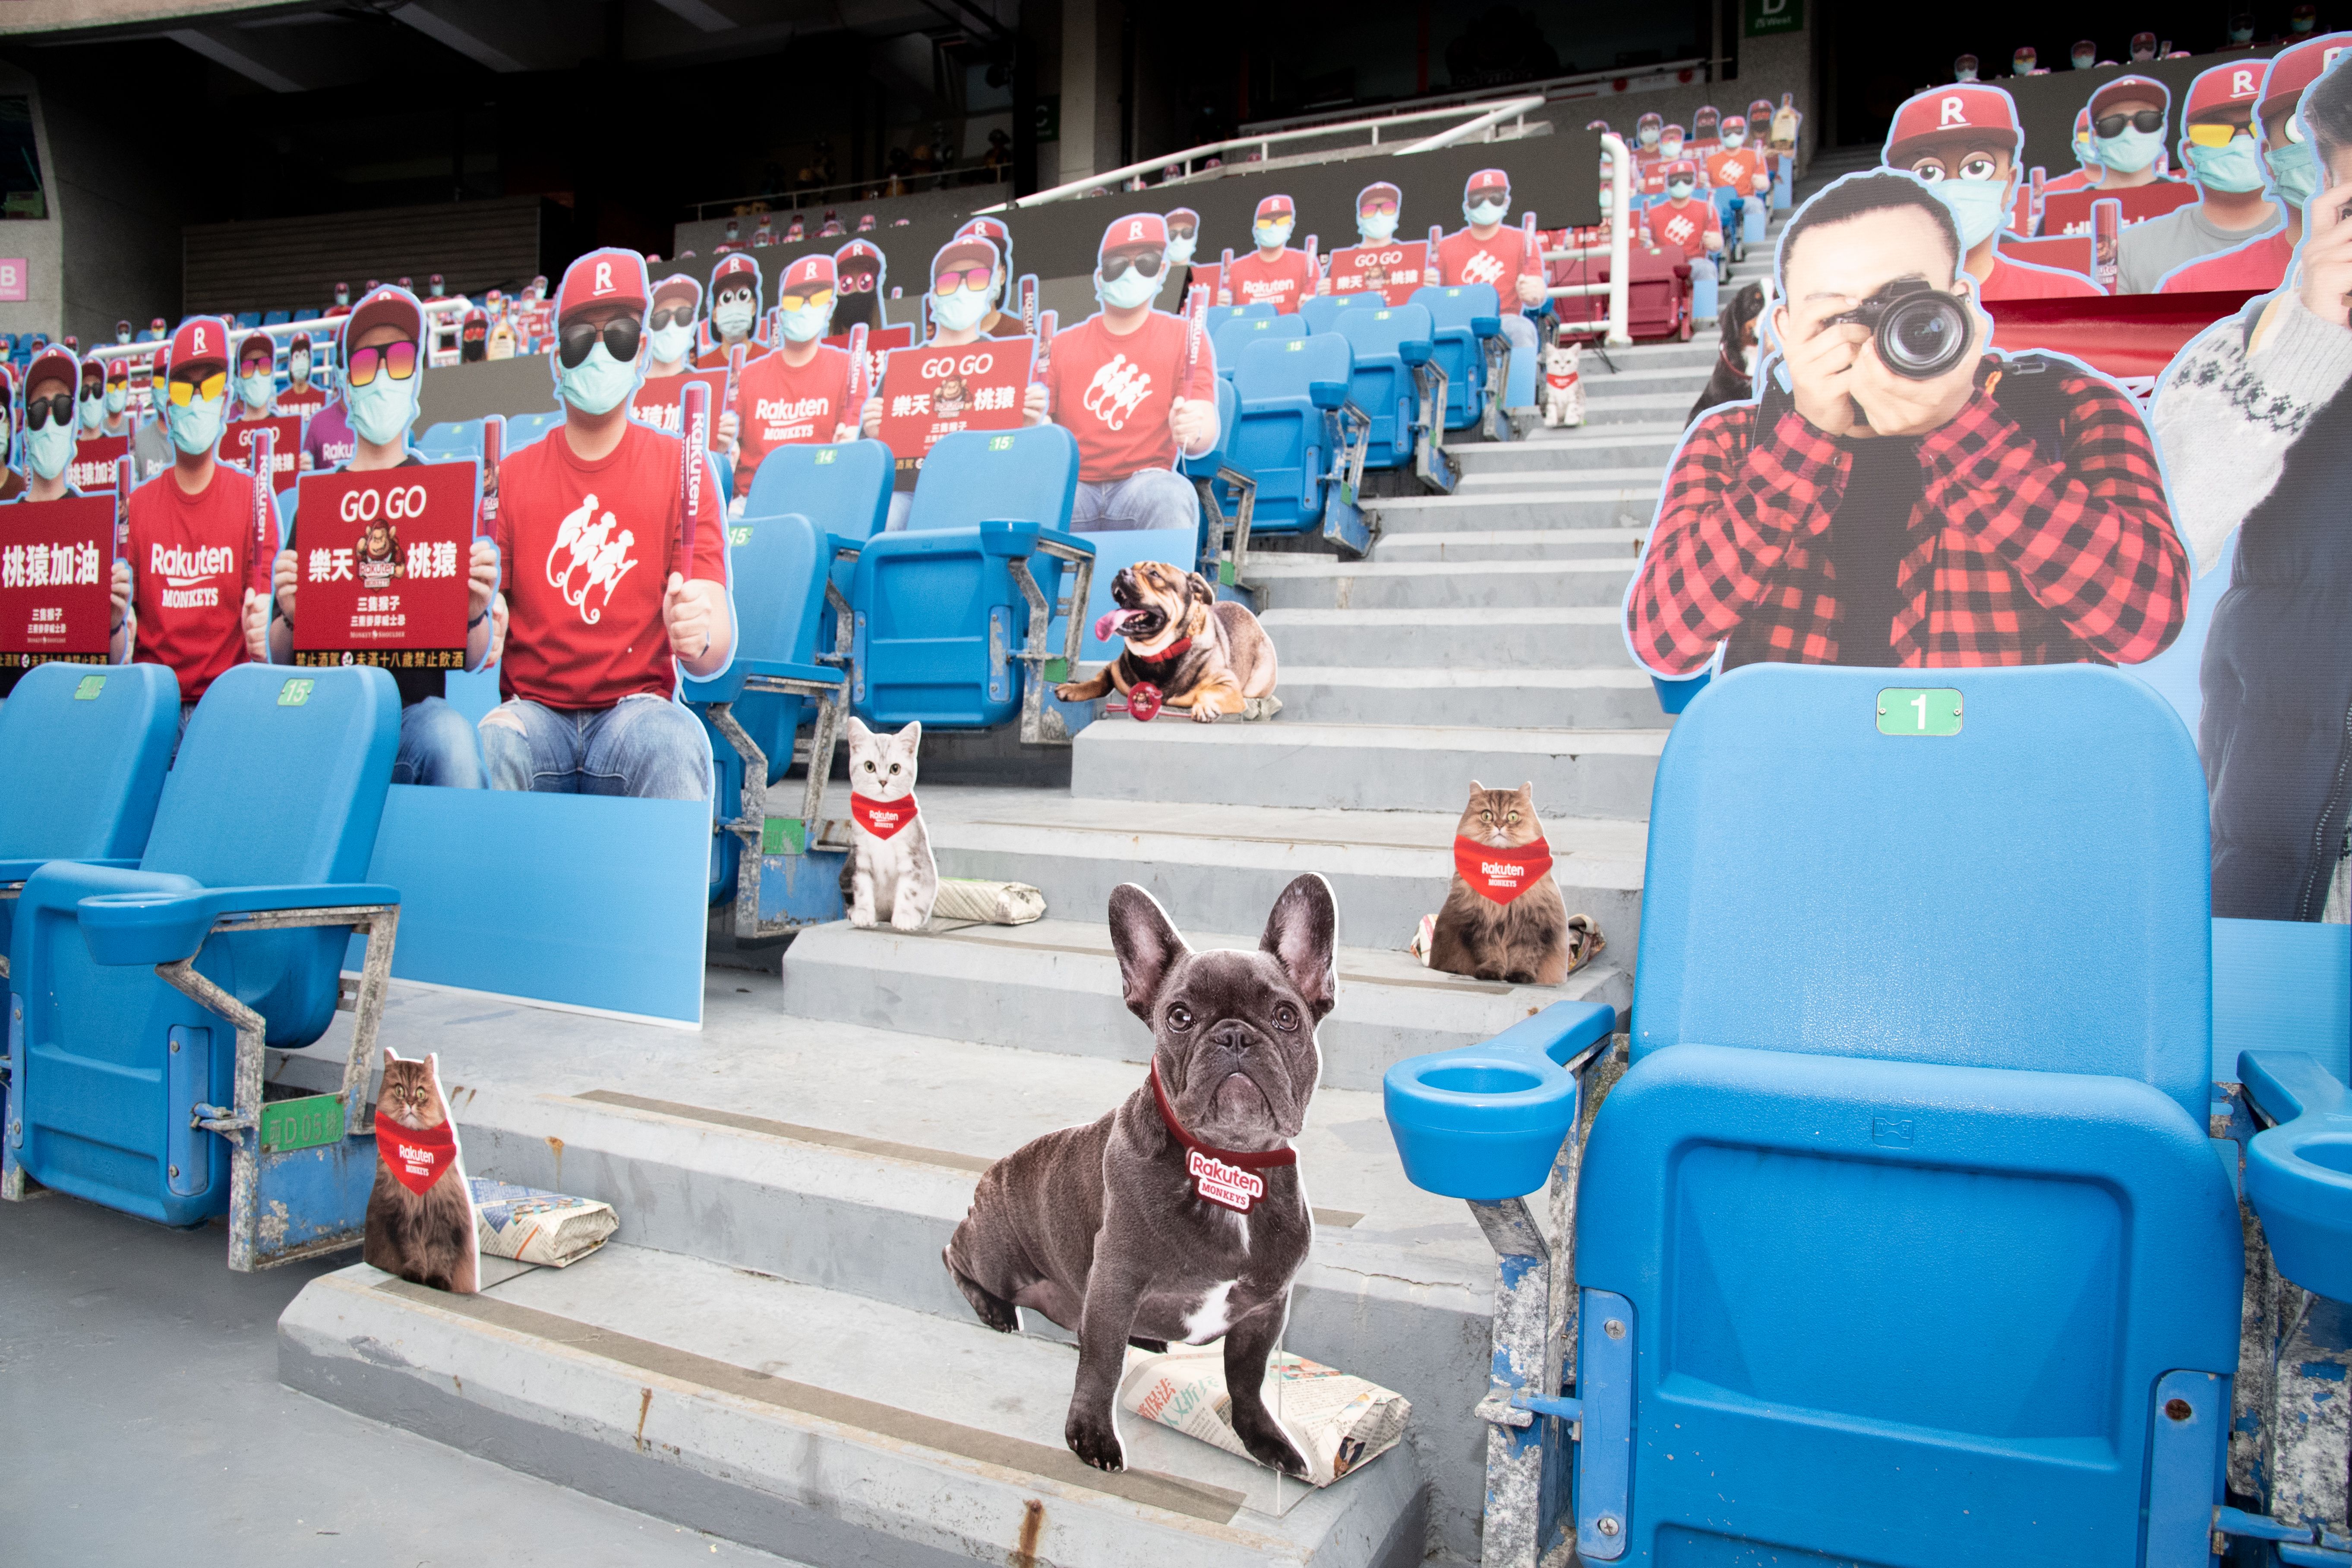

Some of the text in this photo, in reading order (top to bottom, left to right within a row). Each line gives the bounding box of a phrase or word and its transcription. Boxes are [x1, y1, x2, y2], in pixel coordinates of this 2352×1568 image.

[2233, 71, 2255, 94] R
[1941, 97, 1967, 125] R
[1130, 221, 1143, 237] R
[853, 244, 863, 256] R
[1354, 251, 1402, 267] GO GO
[729, 257, 741, 272] R
[806, 262, 817, 277] R
[1, 266, 16, 286] B
[596, 262, 612, 289] R
[1243, 279, 1294, 293] Rakuten
[193, 327, 206, 350] R
[922, 354, 993, 379] GO GO
[755, 398, 828, 420] Rakuten
[891, 394, 930, 417] 樂天
[974, 385, 1015, 411] 桃猿
[763, 425, 813, 440] MONKEYS
[994, 436, 1010, 449] 15
[688, 413, 704, 516] Rakuten
[819, 450, 833, 462] 14
[258, 455, 268, 541] Rakuten
[340, 485, 426, 522] GO GO
[731, 528, 748, 544] 15
[2, 540, 99, 588] 桃猿加油
[151, 543, 234, 577] Rakuten
[309, 541, 457, 583] 樂天 桃猿
[161, 588, 218, 608] MONKEYS
[287, 681, 307, 702] 15
[1910, 694, 1926, 729] 1
[869, 810, 898, 821] Rakuten
[1482, 862, 1524, 876] Rakuten
[1488, 879, 1517, 887] MONKEYS
[399, 1144, 434, 1164] Rakuten
[1193, 1156, 1259, 1193] Rakuten
[1202, 1182, 1247, 1205] MONKEYS
